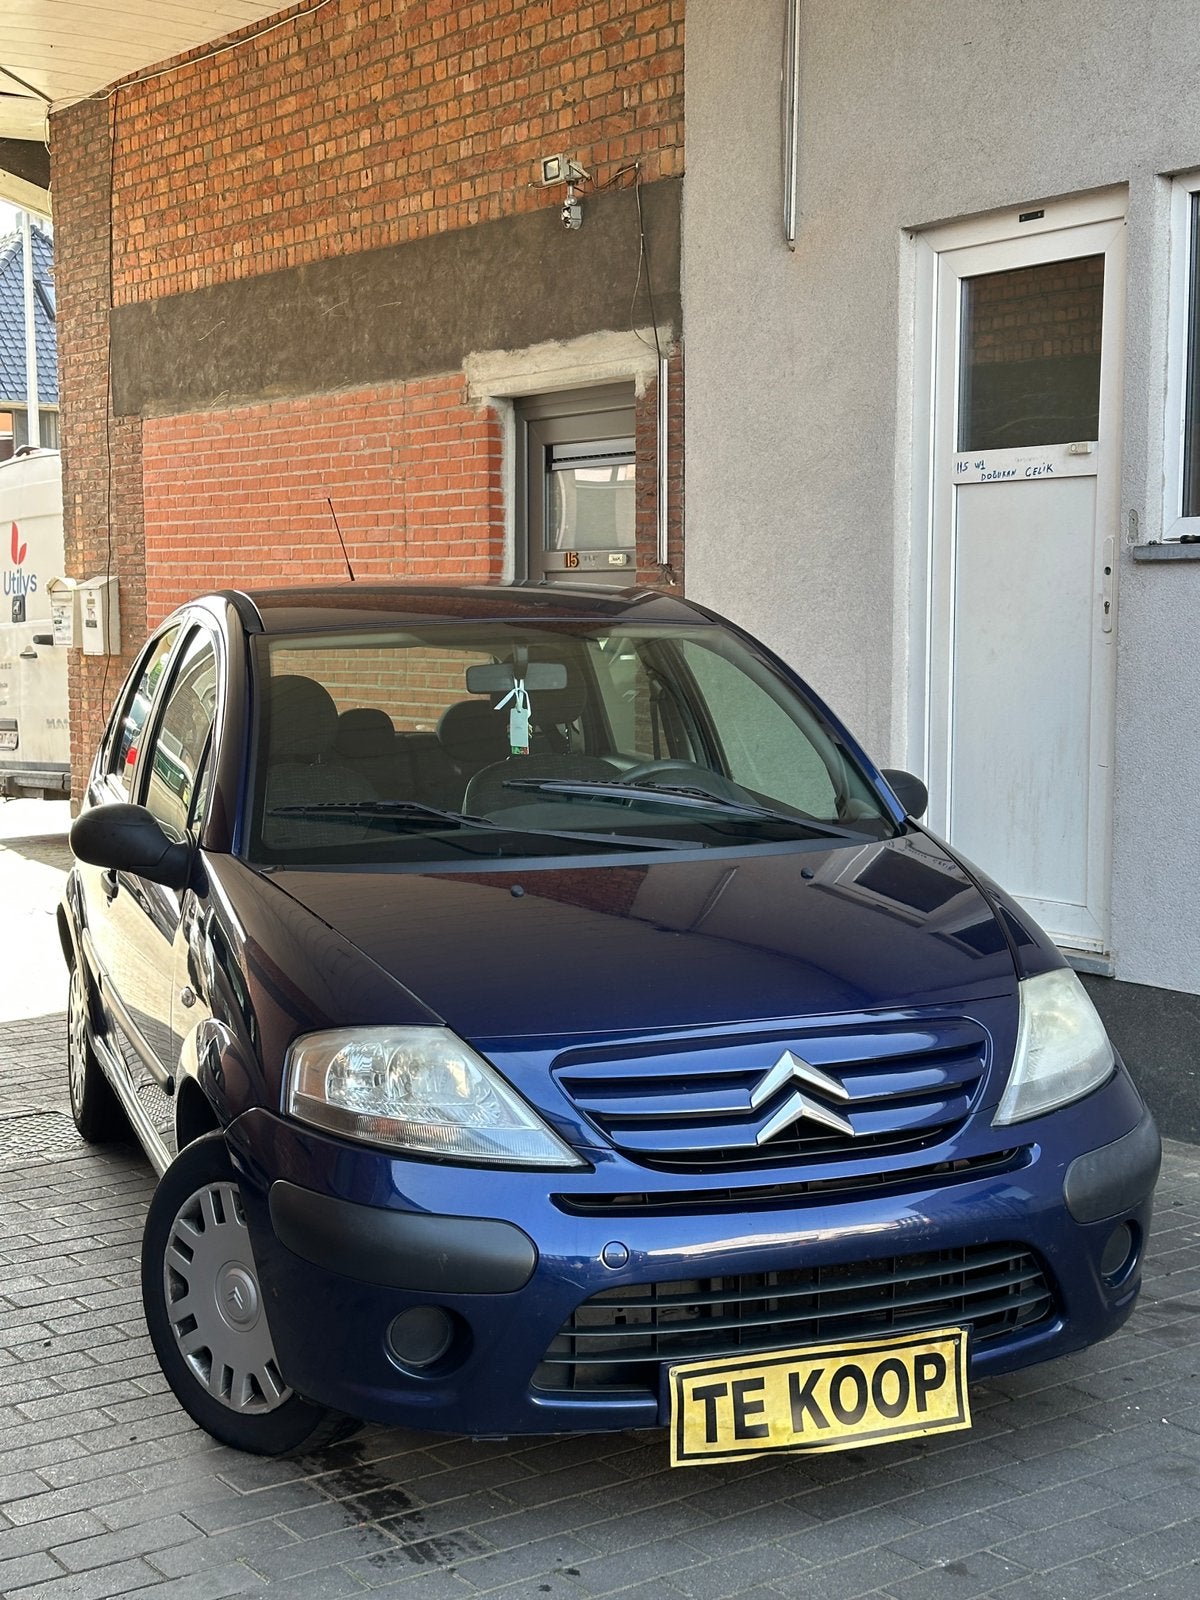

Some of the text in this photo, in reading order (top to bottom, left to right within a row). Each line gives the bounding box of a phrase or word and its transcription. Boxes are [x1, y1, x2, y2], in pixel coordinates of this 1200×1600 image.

[564, 551, 579, 568] 15
[3, 567, 37, 597] Utilys
[692, 1352, 947, 1443] TE KOOP
